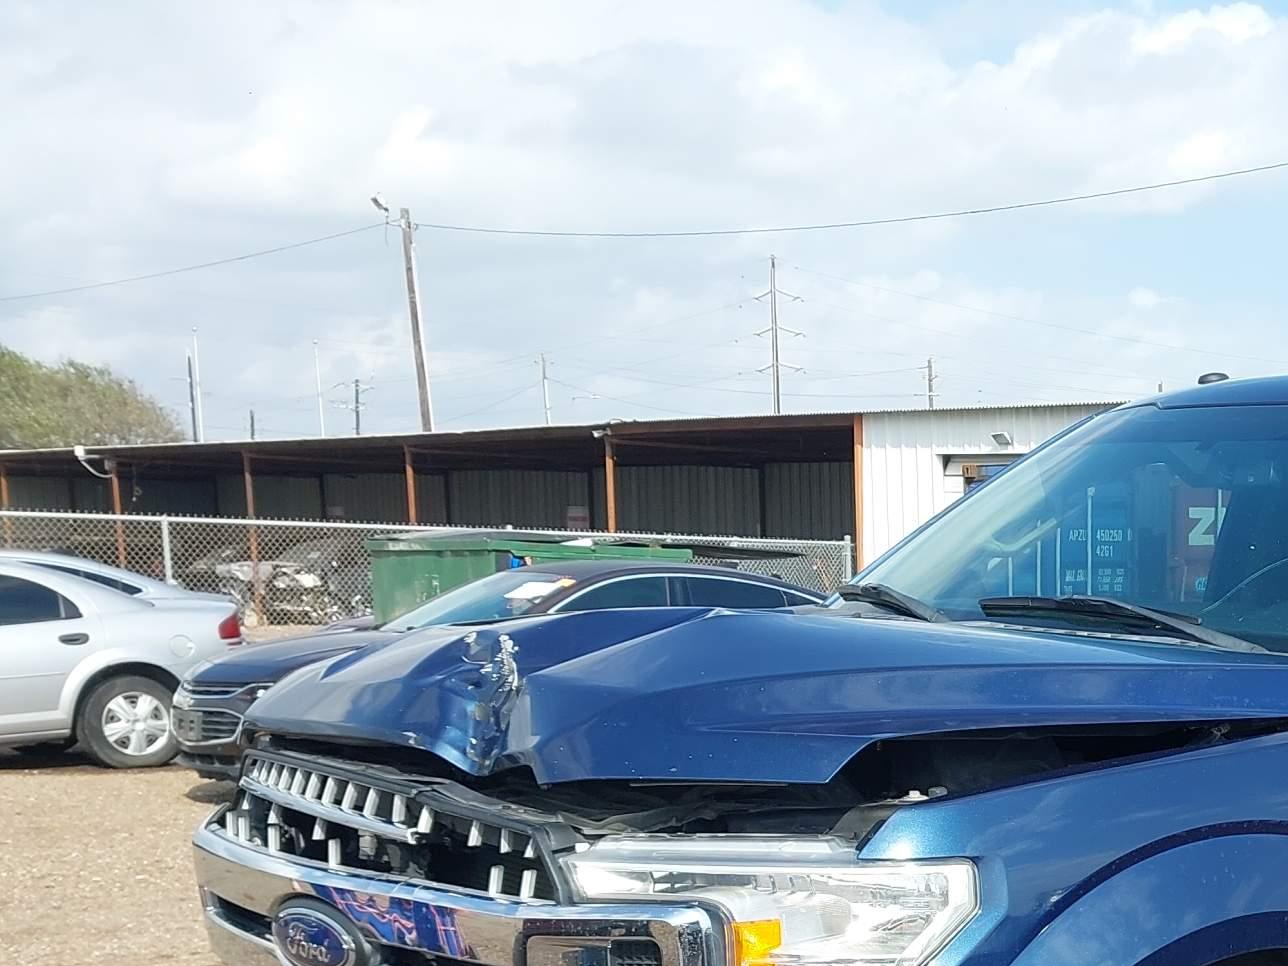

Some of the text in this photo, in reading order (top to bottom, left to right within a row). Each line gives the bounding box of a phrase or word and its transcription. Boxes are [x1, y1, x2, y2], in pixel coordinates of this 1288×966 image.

[1096, 528, 1123, 542] 450250
[1095, 544, 1113, 557] 42G1
[286, 921, 331, 963] Ford
